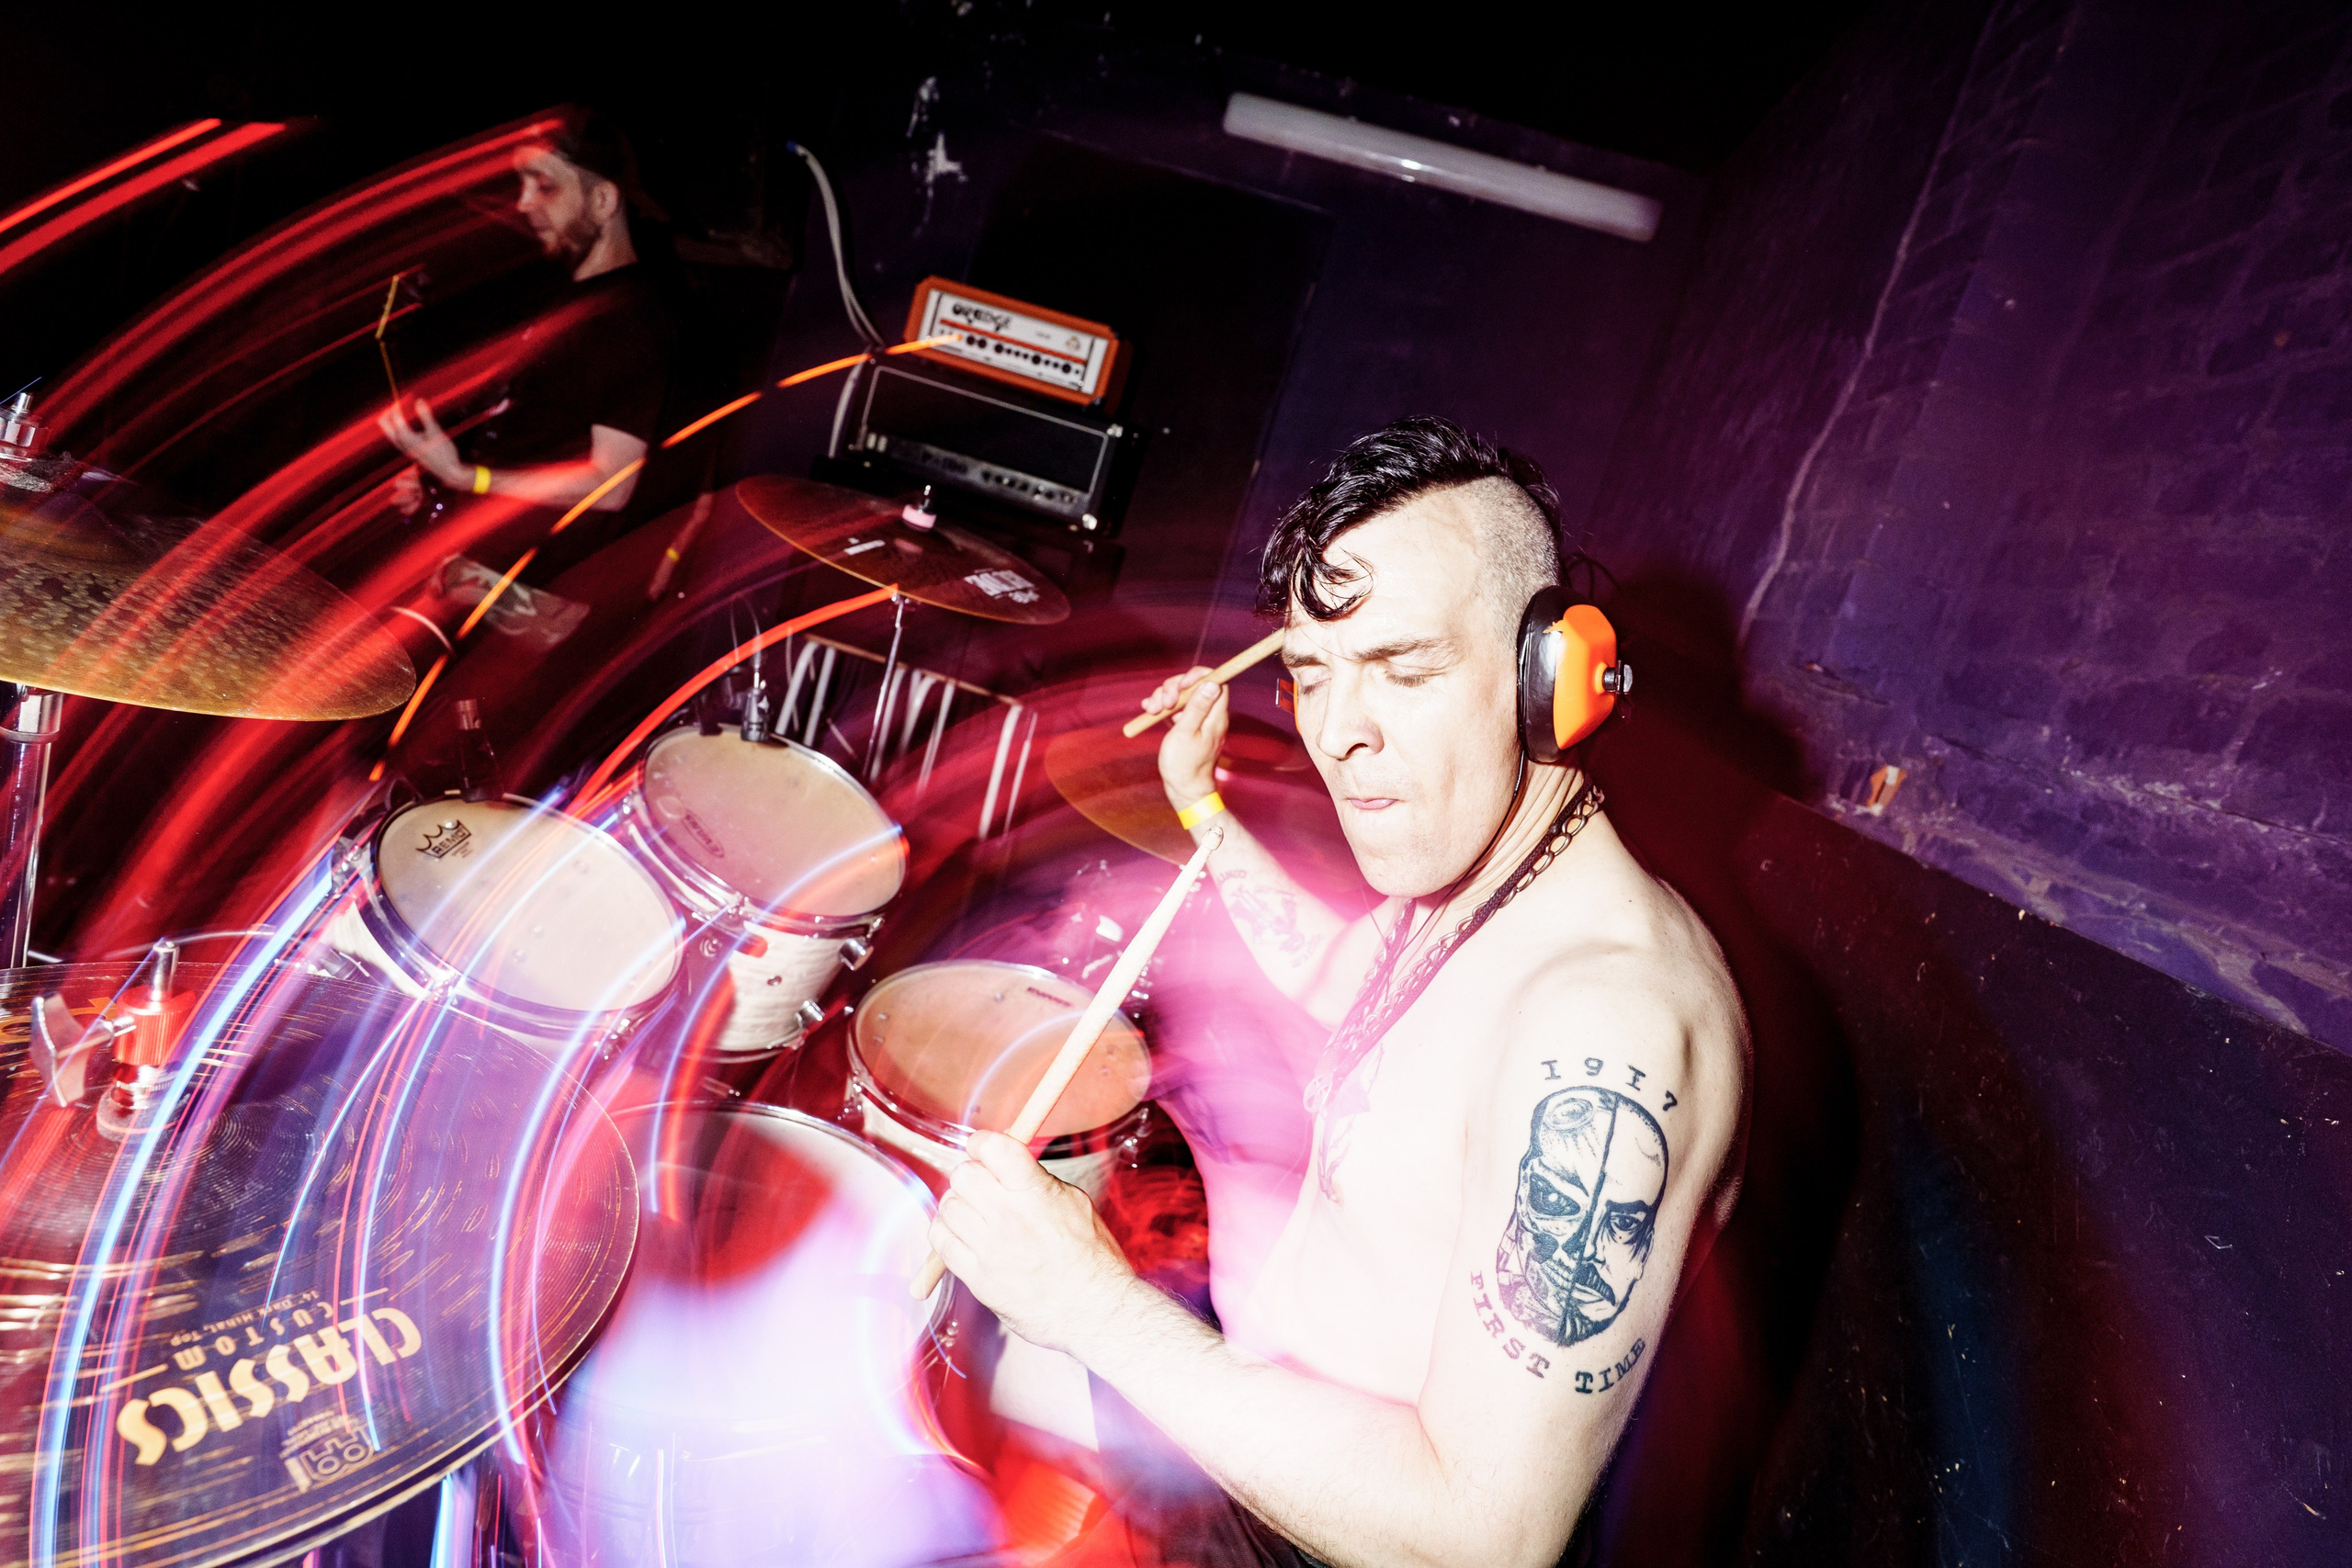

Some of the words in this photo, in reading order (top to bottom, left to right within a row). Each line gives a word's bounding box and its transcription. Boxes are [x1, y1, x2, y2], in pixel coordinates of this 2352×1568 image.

[432, 828, 466, 854] REMO
[1541, 1057, 1678, 1111] 1917
[170, 1330, 203, 1348] Top
[173, 1302, 334, 1371] CUSTOM
[1470, 1269, 1550, 1379] FIRST
[1575, 1337, 1646, 1394] TIME
[117, 1307, 422, 1465] CLASSICS
